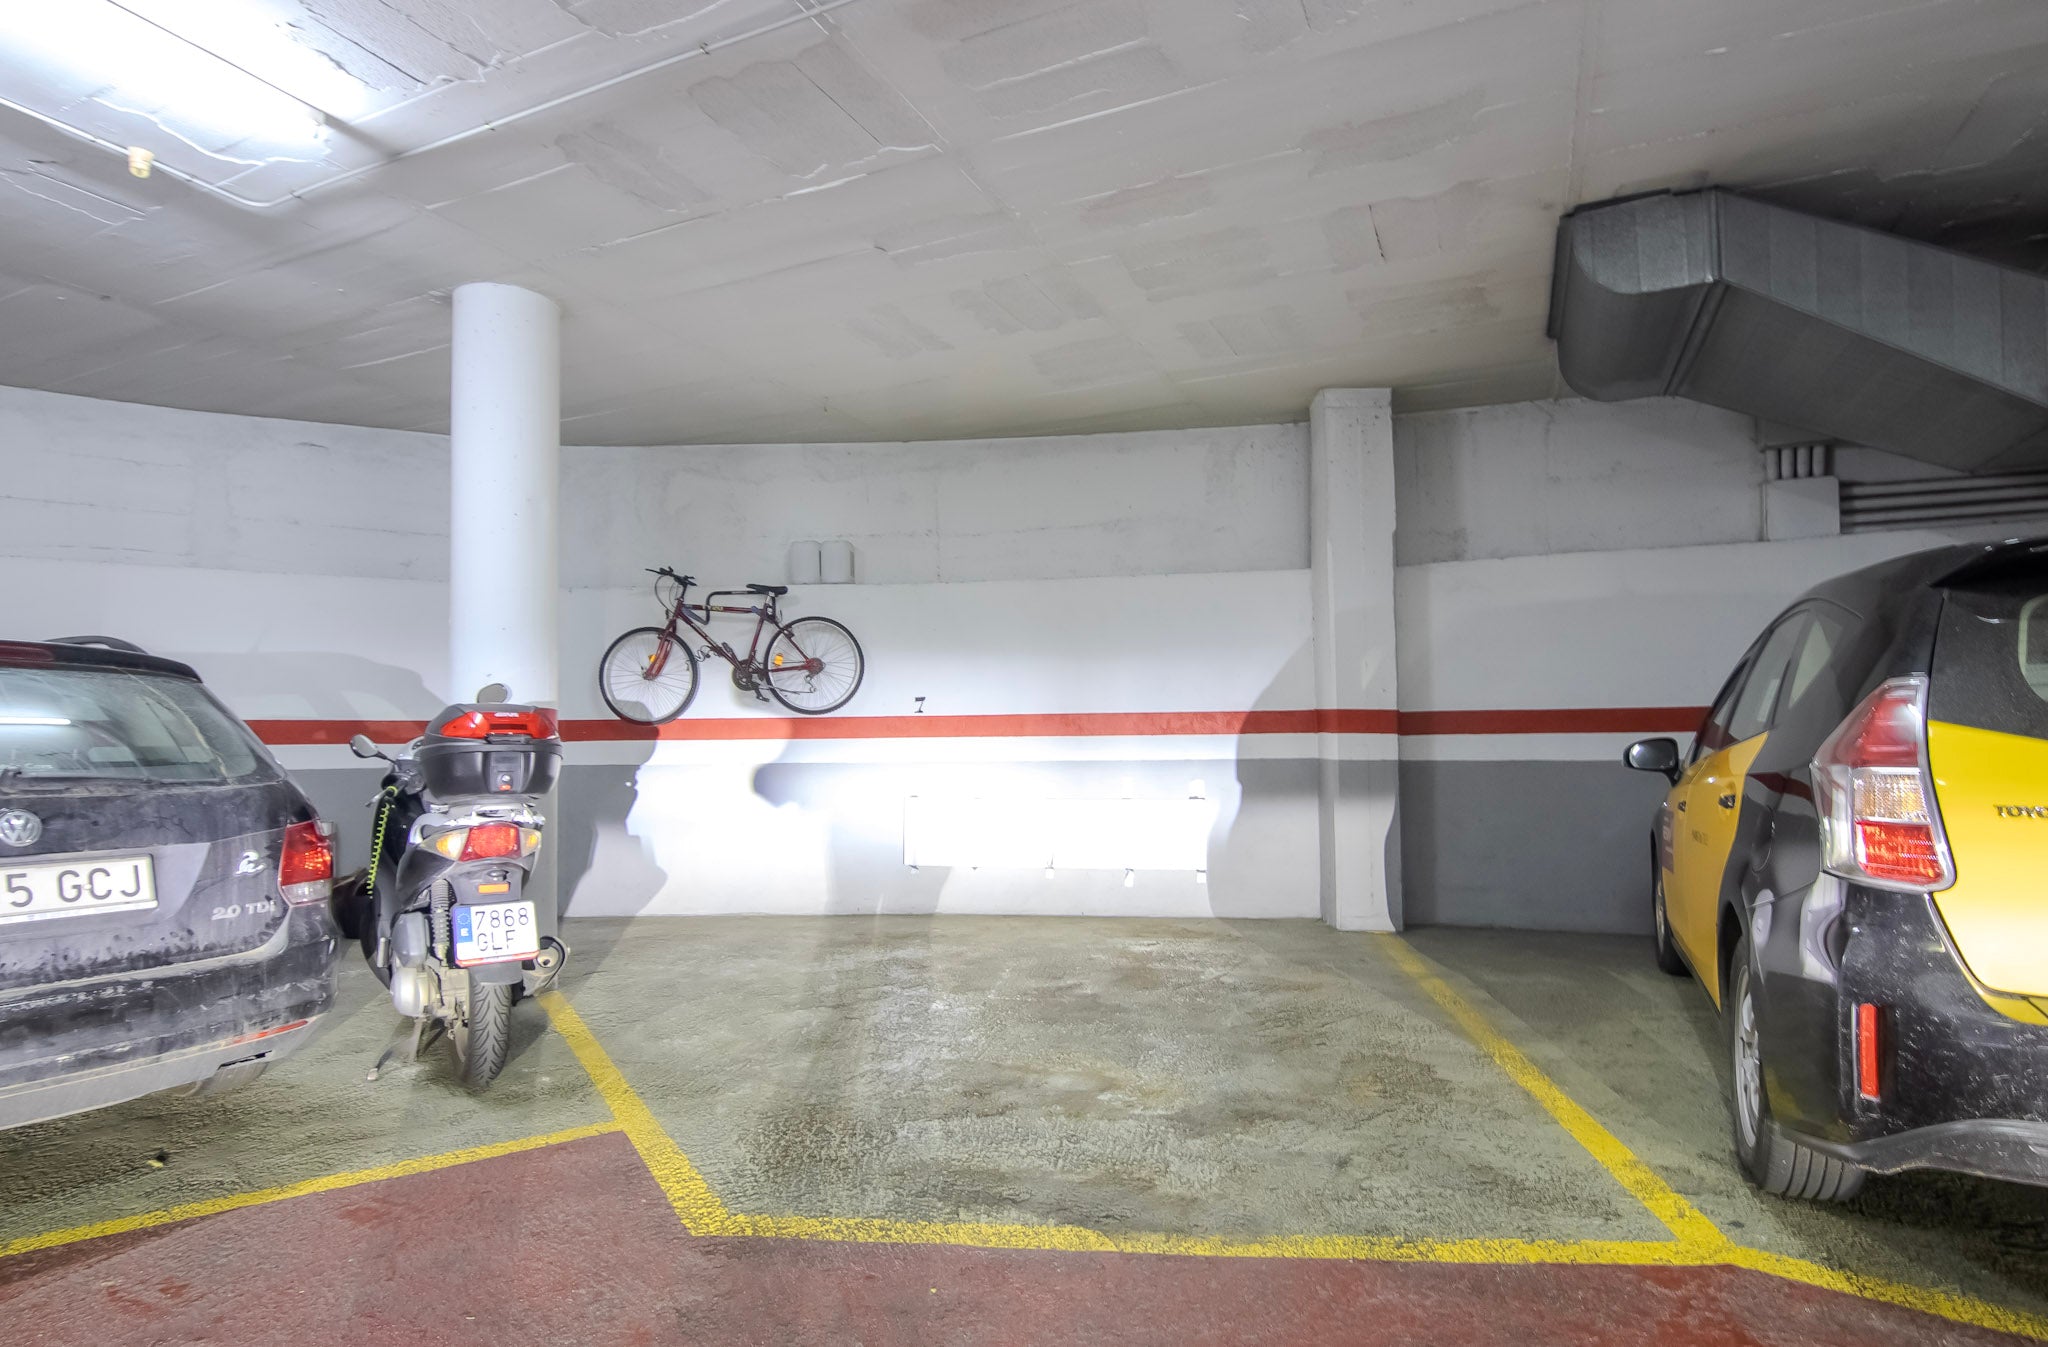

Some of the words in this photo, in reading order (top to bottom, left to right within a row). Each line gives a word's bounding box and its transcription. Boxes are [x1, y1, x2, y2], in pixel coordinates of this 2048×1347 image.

[914, 697, 926, 713] 7
[6, 873, 33, 908] 5
[58, 865, 141, 902] GCJ
[475, 907, 529, 930] 7868
[477, 929, 516, 952] GLF
